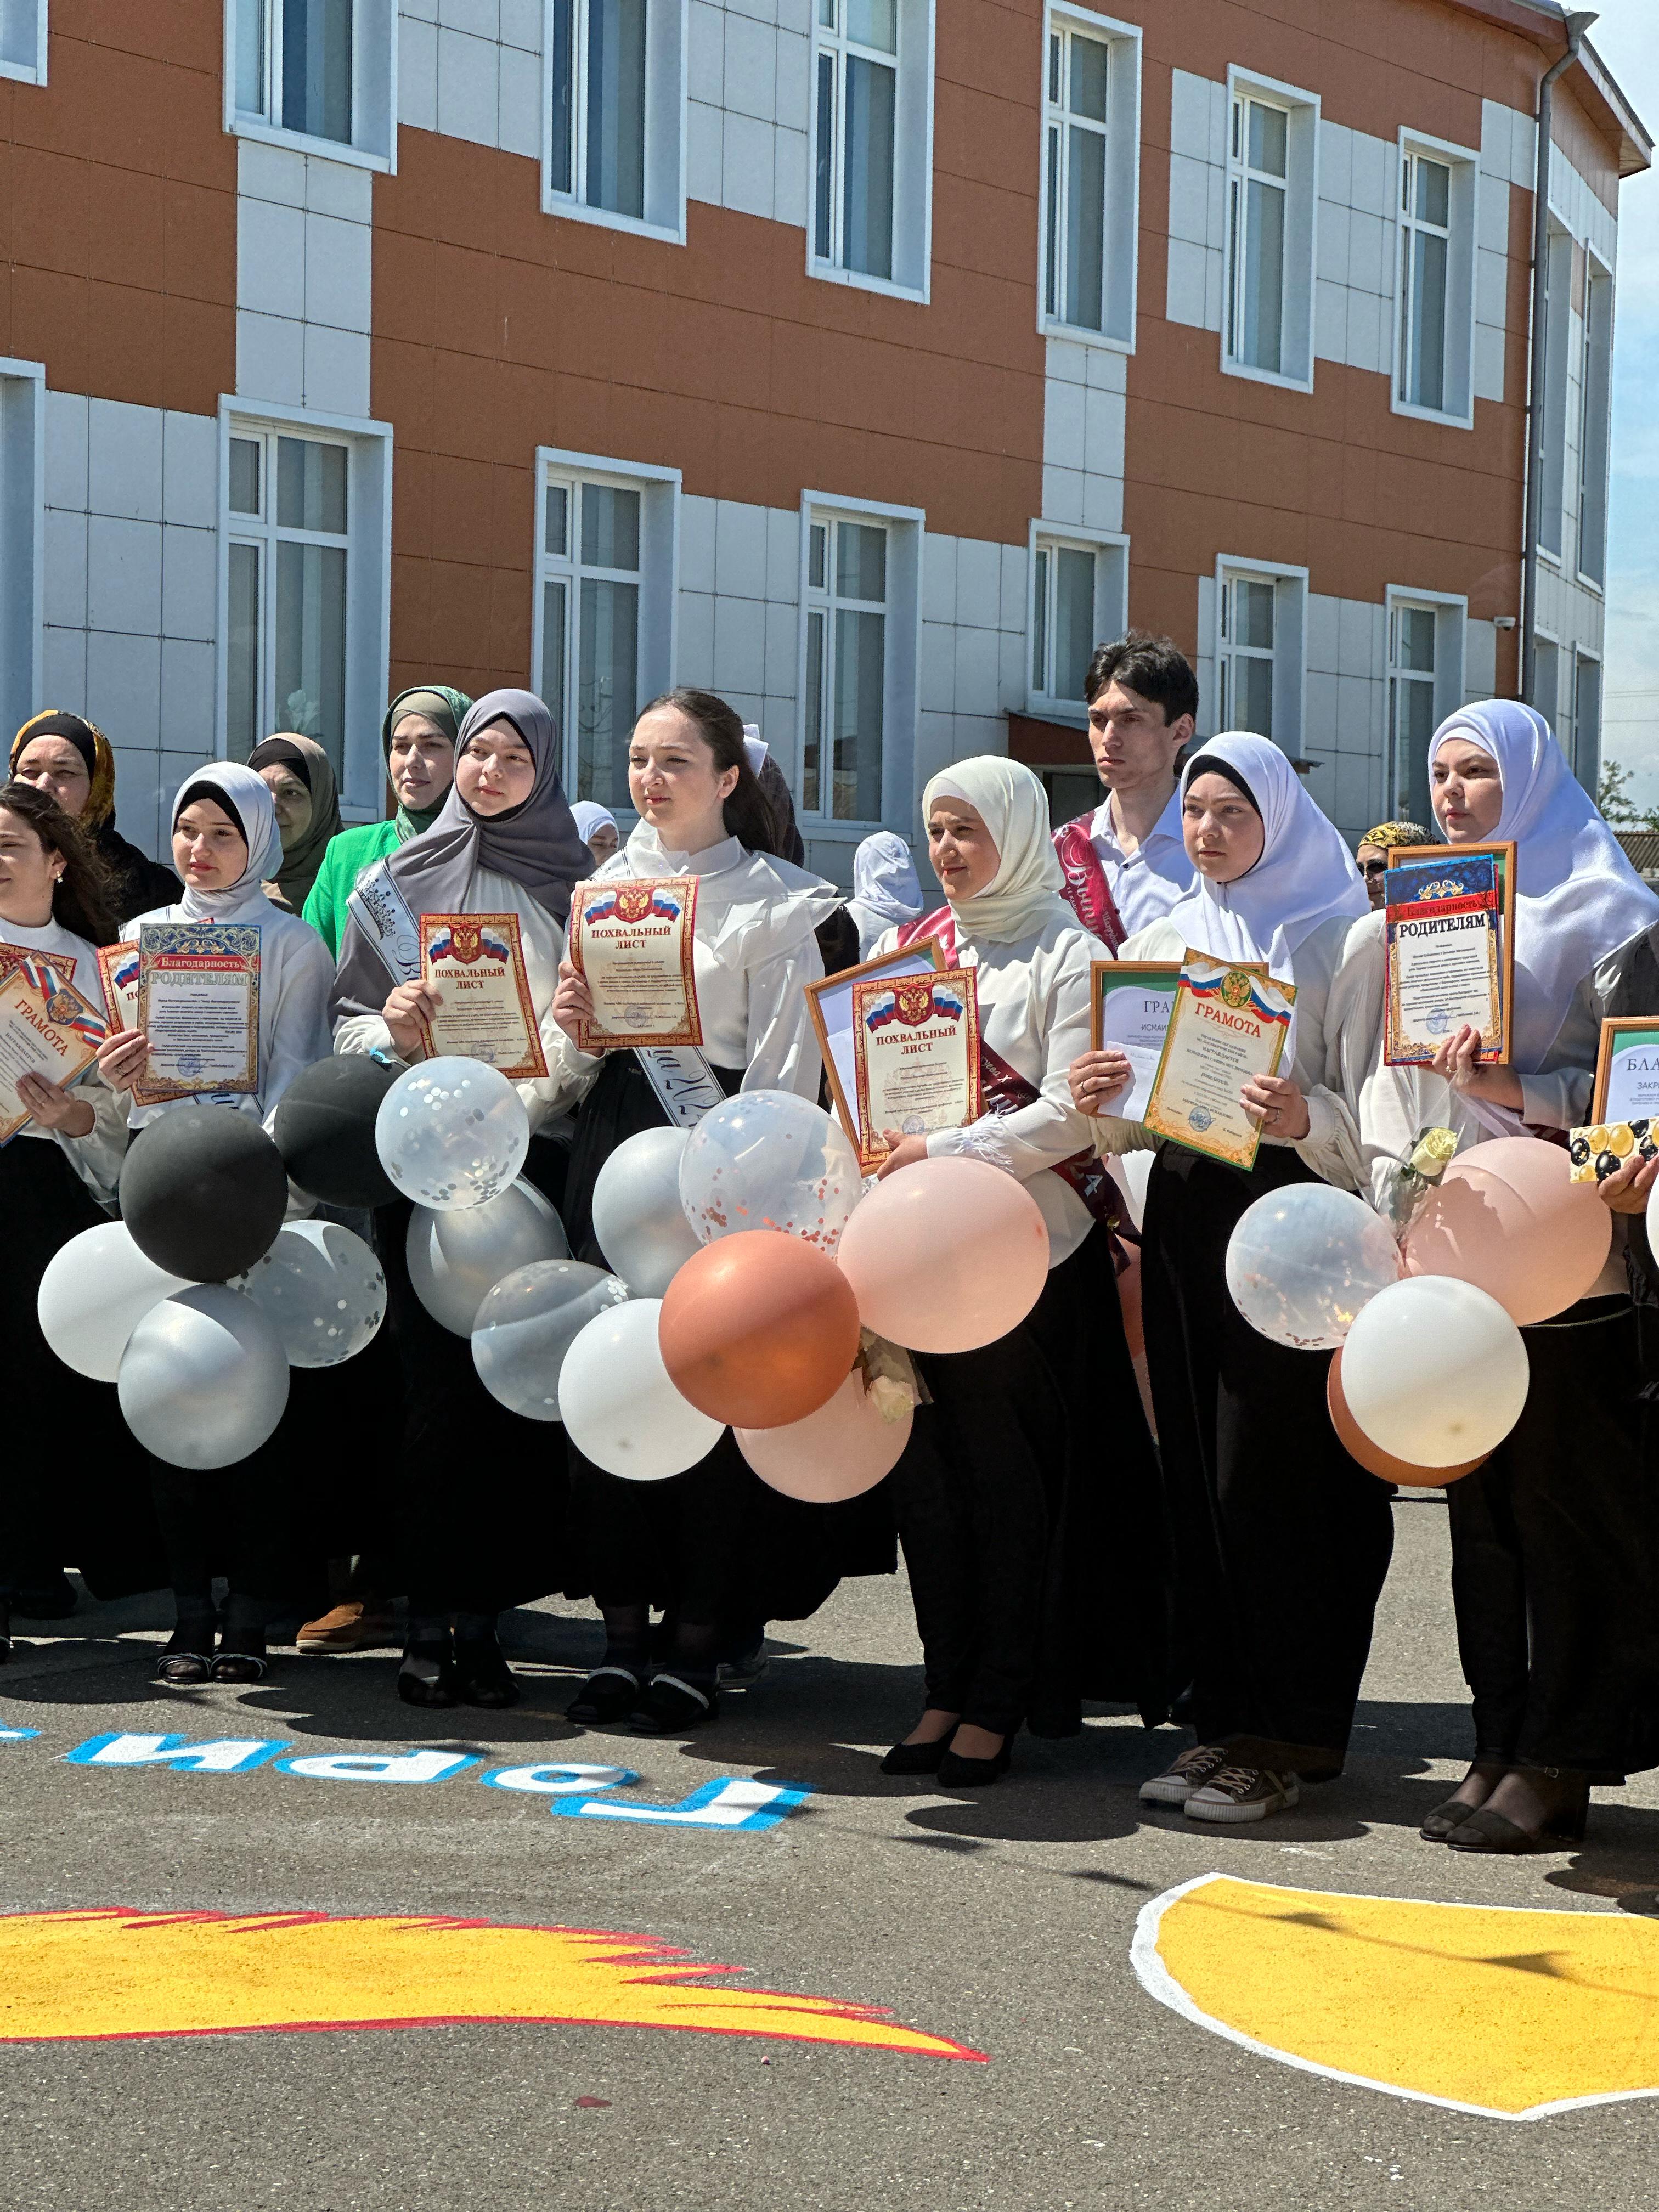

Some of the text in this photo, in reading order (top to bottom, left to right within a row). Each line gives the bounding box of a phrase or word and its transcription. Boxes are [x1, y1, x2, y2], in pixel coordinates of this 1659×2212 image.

[1407, 900, 1477, 916] Благодарность
[1399, 913, 1485, 938] РОДИТЕЛЯМ
[591, 926, 672, 939] ПОХВАЛЬНЫЙ
[616, 940, 646, 950] ЛИСТ
[161, 957, 240, 969] Благодарность
[151, 972, 247, 986] РОДИТЕЛЯМ
[435, 967, 505, 978] ПОХВАЛЬНЫЙ
[456, 980, 484, 989] ЛИСТ
[1144, 1000, 1174, 1013] ГРА
[1194, 1001, 1261, 1038] ГРАМОТА
[14, 998, 69, 1057] ГРАМОТА
[876, 1025, 957, 1046] ПОХВАЛЬНЫЙ
[901, 1043, 933, 1055] ЛИСТ
[1637, 1081, 1659, 1090] ЗАКР
[663, 1070, 720, 1127] 202
